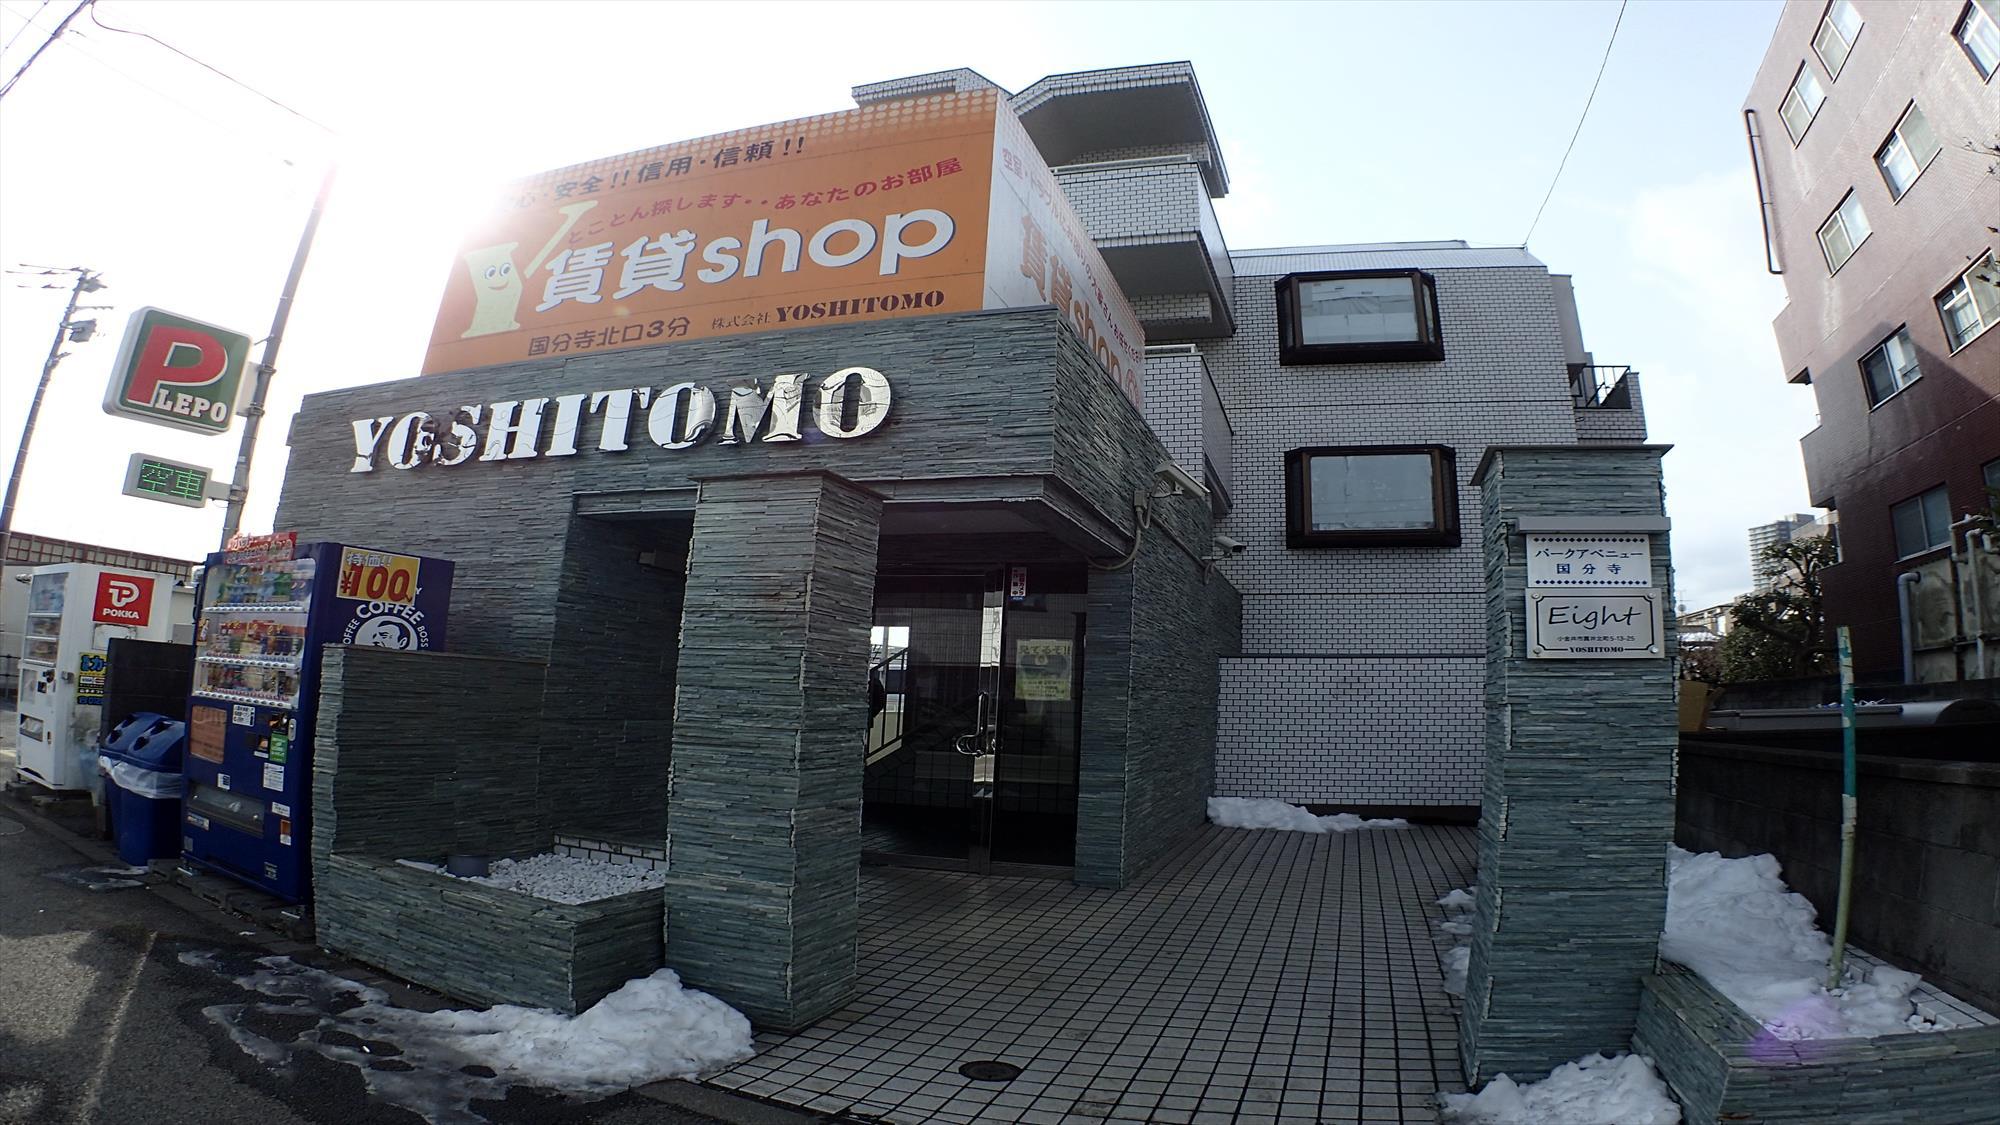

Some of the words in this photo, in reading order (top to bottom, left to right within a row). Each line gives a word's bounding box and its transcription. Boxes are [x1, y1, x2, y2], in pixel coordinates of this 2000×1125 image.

[535, 207, 956, 313] 賃貸shop
[711, 310, 772, 331] 株式会社
[775, 289, 945, 324] YOSHITOMO
[527, 316, 691, 357] 国分寺北口3分
[349, 366, 892, 474] YOSHITOMO
[136, 462, 207, 500] 空車
[1535, 547, 1644, 560] パークアベニュー
[102, 607, 141, 620] POKKA
[356, 601, 424, 625] COFFEE
[1548, 605, 1642, 631] Eight
[416, 625, 429, 648] BOSS
[1568, 646, 1625, 654] YOSHITOMO
